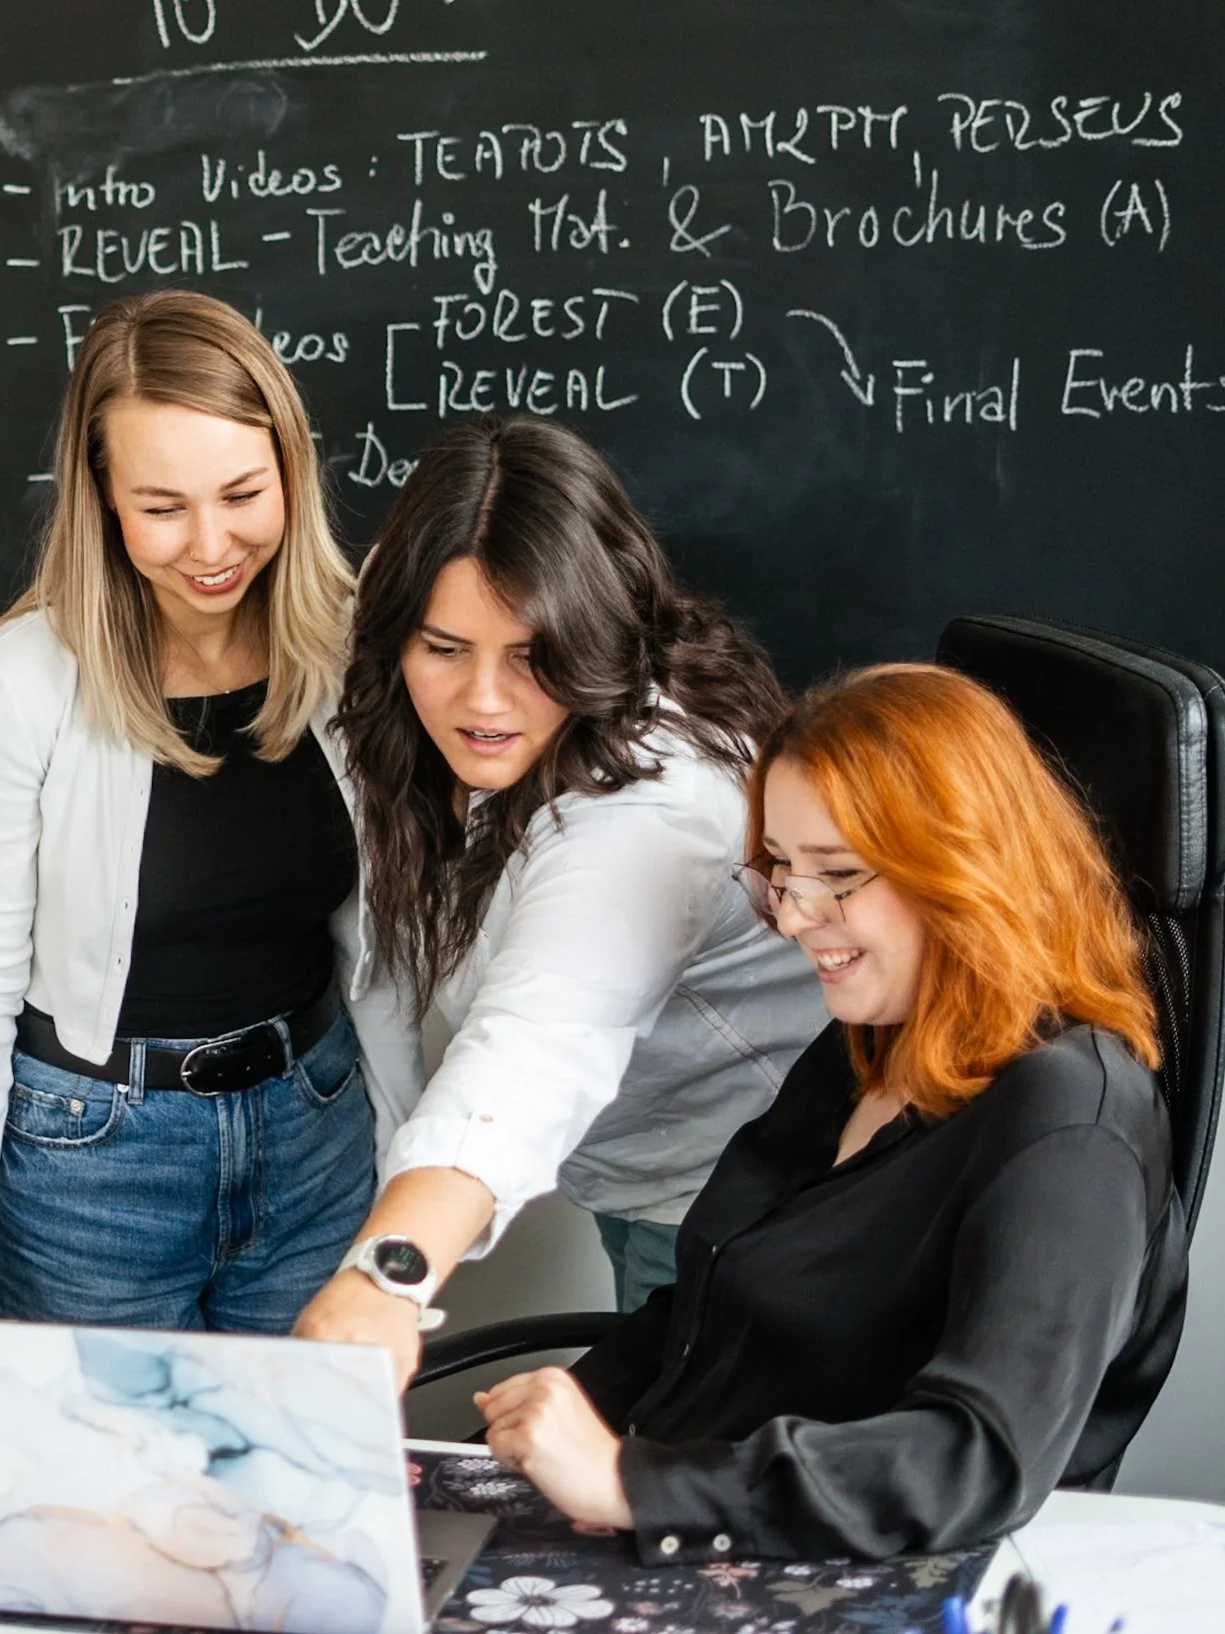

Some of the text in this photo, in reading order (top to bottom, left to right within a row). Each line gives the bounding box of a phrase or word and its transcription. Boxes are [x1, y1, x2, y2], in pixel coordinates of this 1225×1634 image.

[937, 91, 1184, 154] PERSEUS
[57, 219, 250, 283] REVEAL
[305, 198, 498, 296] Teaching
[668, 184, 732, 258] &
[768, 168, 1067, 253] Brochures
[1100, 178, 1172, 253] (A)
[432, 278, 744, 349] FOREST (E)
[437, 346, 768, 420] REVEAL (T)
[892, 356, 1020, 433] Final
